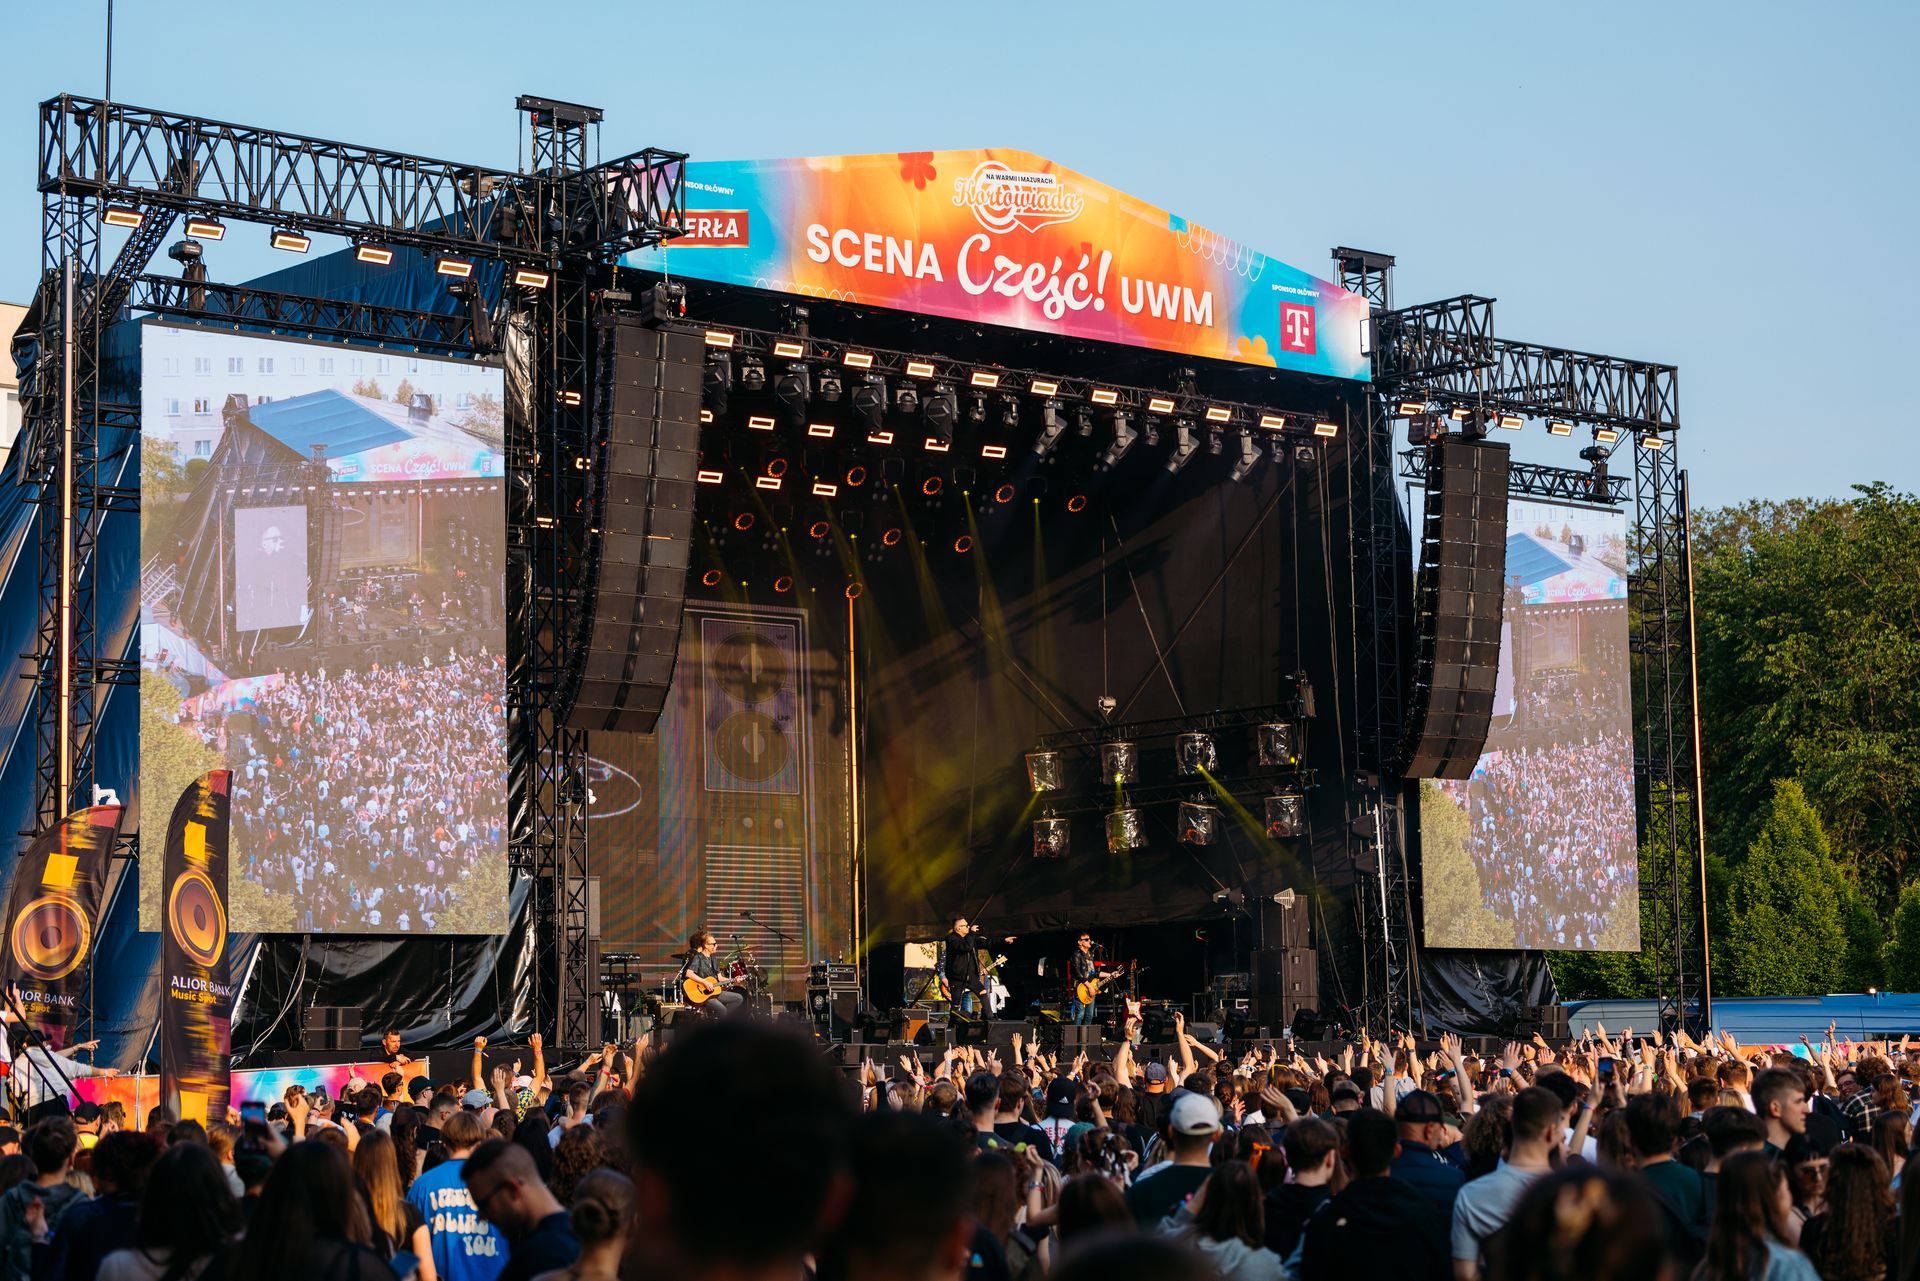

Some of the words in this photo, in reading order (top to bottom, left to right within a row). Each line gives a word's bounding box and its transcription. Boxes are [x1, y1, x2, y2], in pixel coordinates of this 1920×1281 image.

[672, 178, 704, 191] SNSOR
[704, 184, 735, 196] GŁÓWNY
[995, 174, 1017, 182] WARMII
[1021, 176, 1053, 184] MAZURACH
[952, 177, 1080, 213] Kortowiada
[806, 223, 944, 283] SCENA
[957, 233, 1113, 320] Cześć!
[1121, 276, 1214, 327] UWM
[1271, 284, 1297, 295] SPONSOR
[371, 463, 401, 474] SCENA
[404, 458, 442, 477] Cześć!
[171, 975, 208, 992] ALIOR
[209, 981, 231, 997] BANK
[20, 990, 41, 1002] IOR
[44, 993, 75, 1006] BANK
[171, 988, 197, 1001] Music
[198, 992, 217, 1004] Spot
